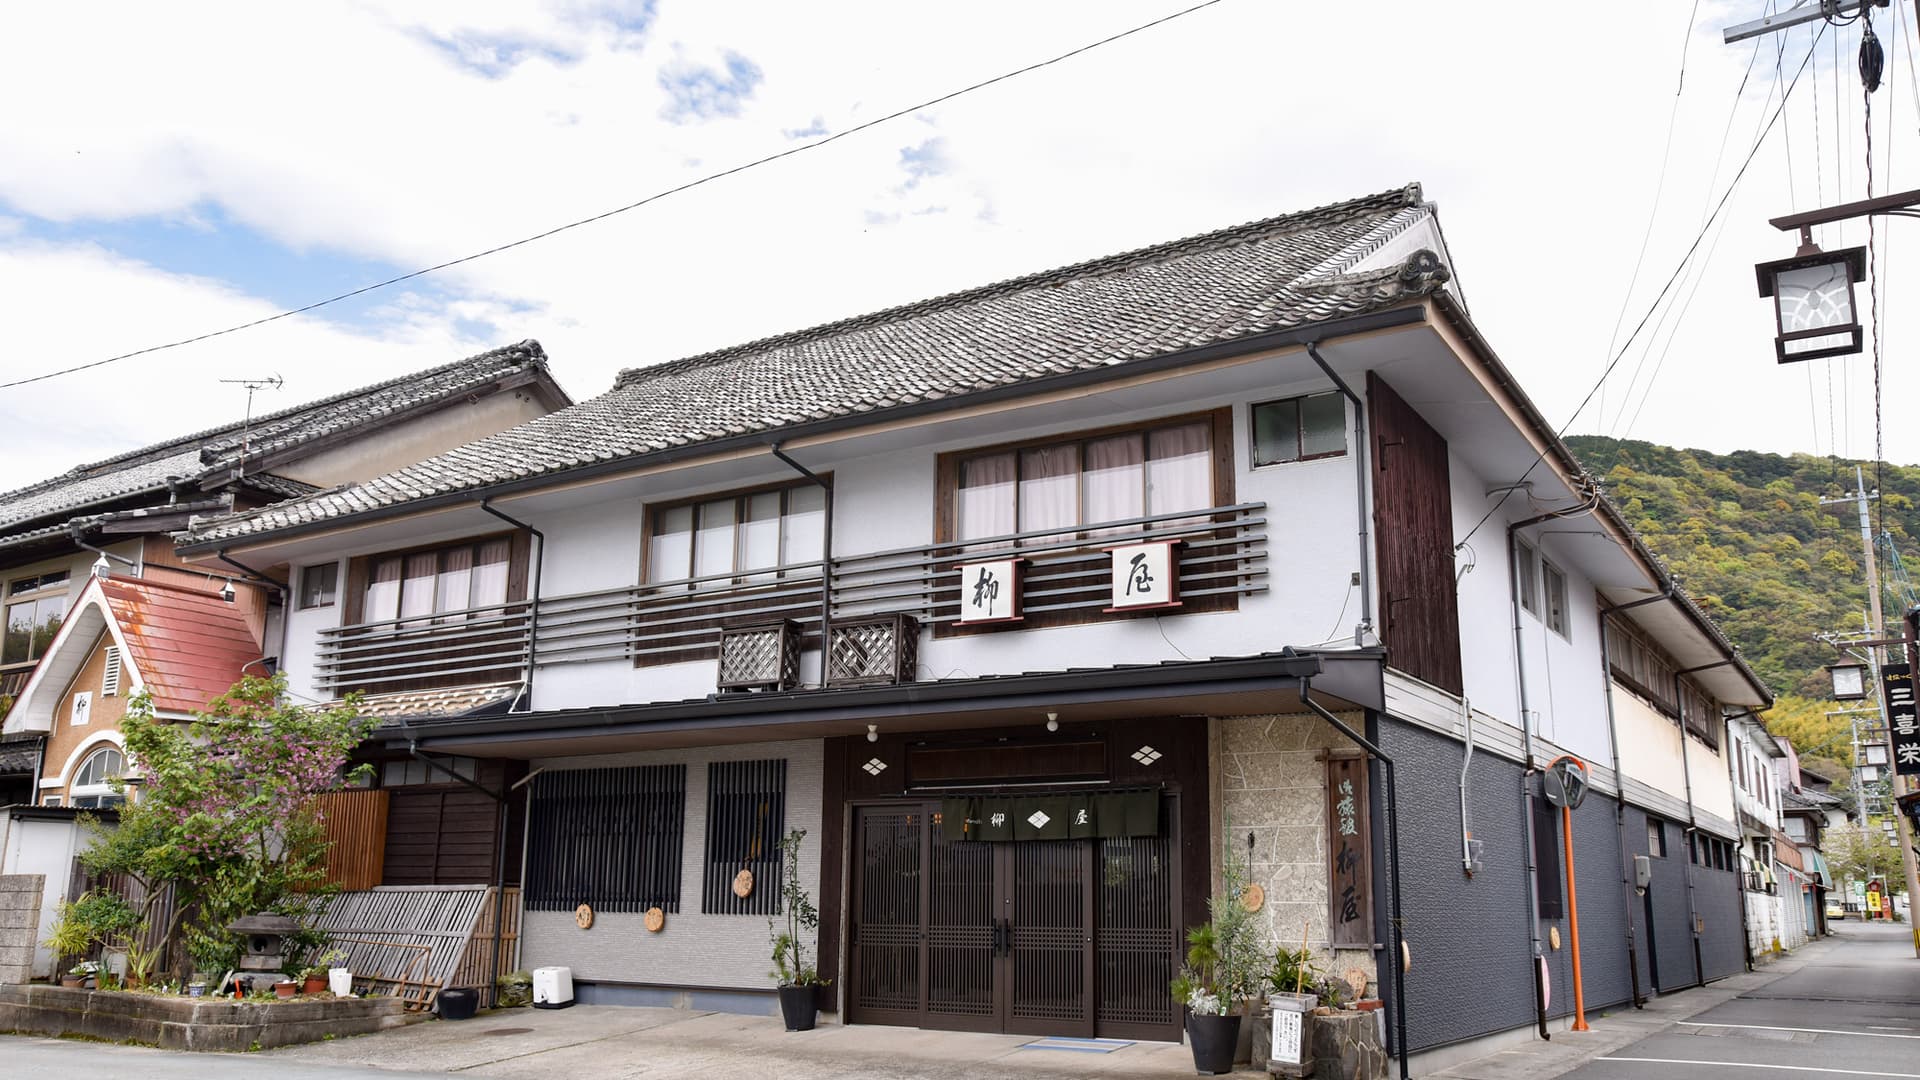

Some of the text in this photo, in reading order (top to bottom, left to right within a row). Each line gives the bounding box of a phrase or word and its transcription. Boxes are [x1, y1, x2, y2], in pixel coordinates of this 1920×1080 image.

[1125, 552, 1154, 596] 屋
[1890, 687, 1920, 765] 三喜栄
[990, 811, 1005, 828] 柳
[1074, 808, 1089, 825] 屋
